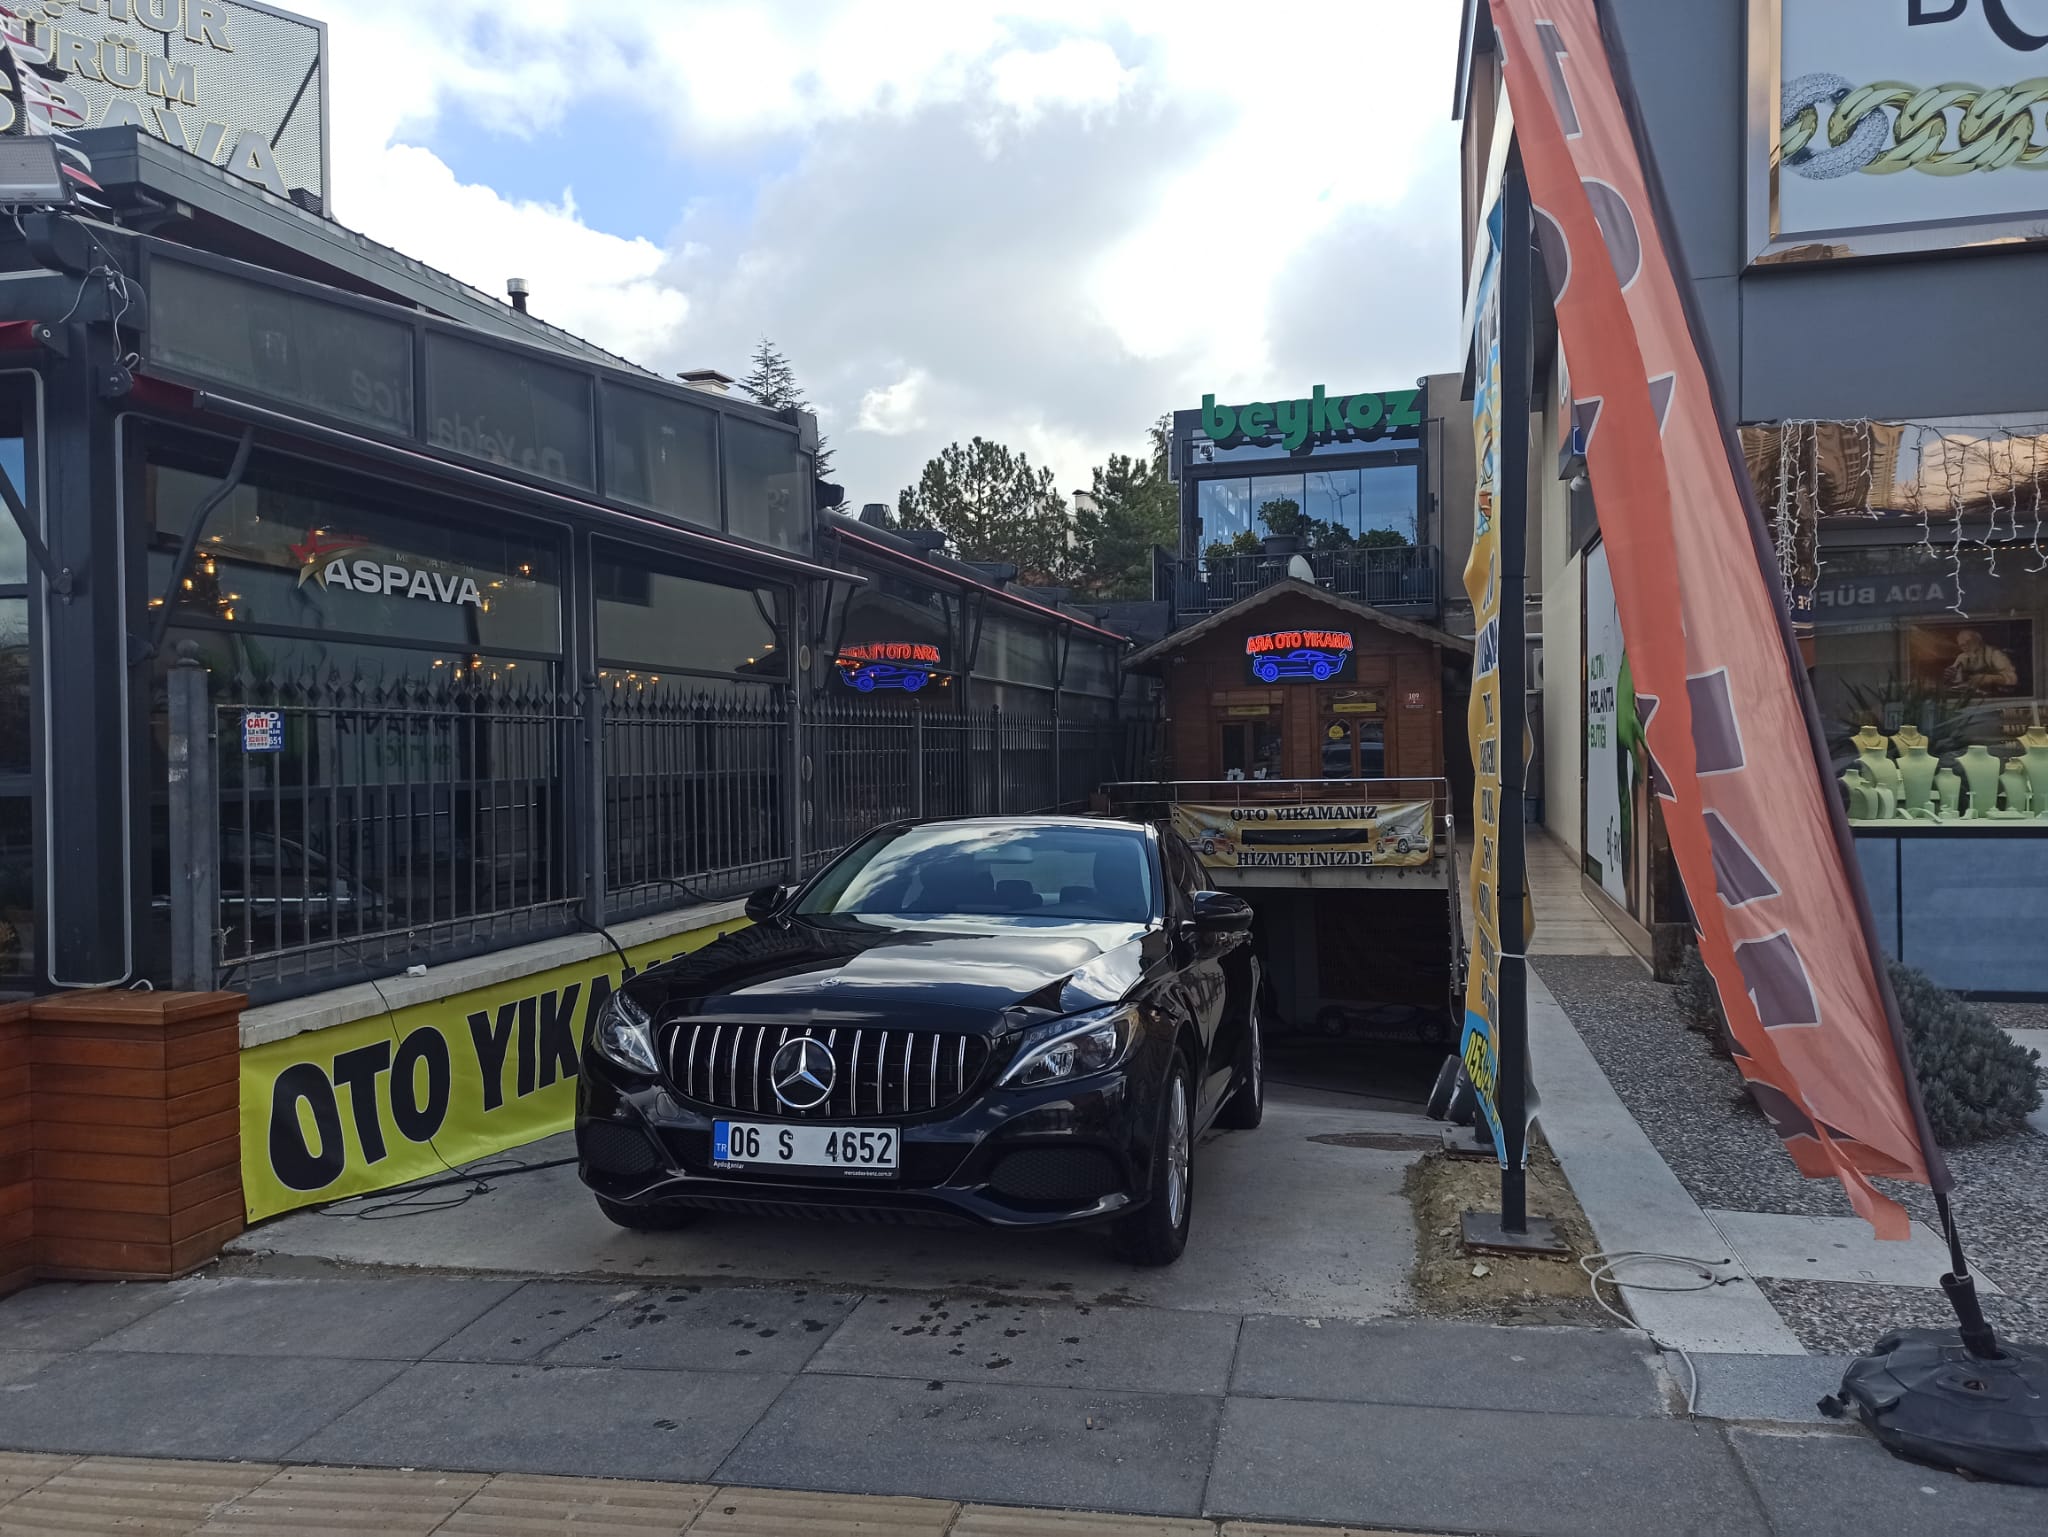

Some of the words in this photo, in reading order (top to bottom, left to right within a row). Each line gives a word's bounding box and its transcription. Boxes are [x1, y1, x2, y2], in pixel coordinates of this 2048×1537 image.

[1202, 384, 1421, 449] beykoz
[324, 558, 482, 607] ASPAVA
[1275, 632, 1302, 648] OTO
[1302, 631, 1353, 650] YIKAMA
[1231, 808, 1268, 821] OTO
[1274, 805, 1378, 821] YIKAMANIZ
[1237, 847, 1373, 866] HİZMETİNİZDE
[269, 1026, 450, 1192] OTO
[716, 1143, 728, 1153] TR
[730, 1126, 760, 1158] 06
[778, 1129, 794, 1160] S
[825, 1131, 893, 1164] 4652
